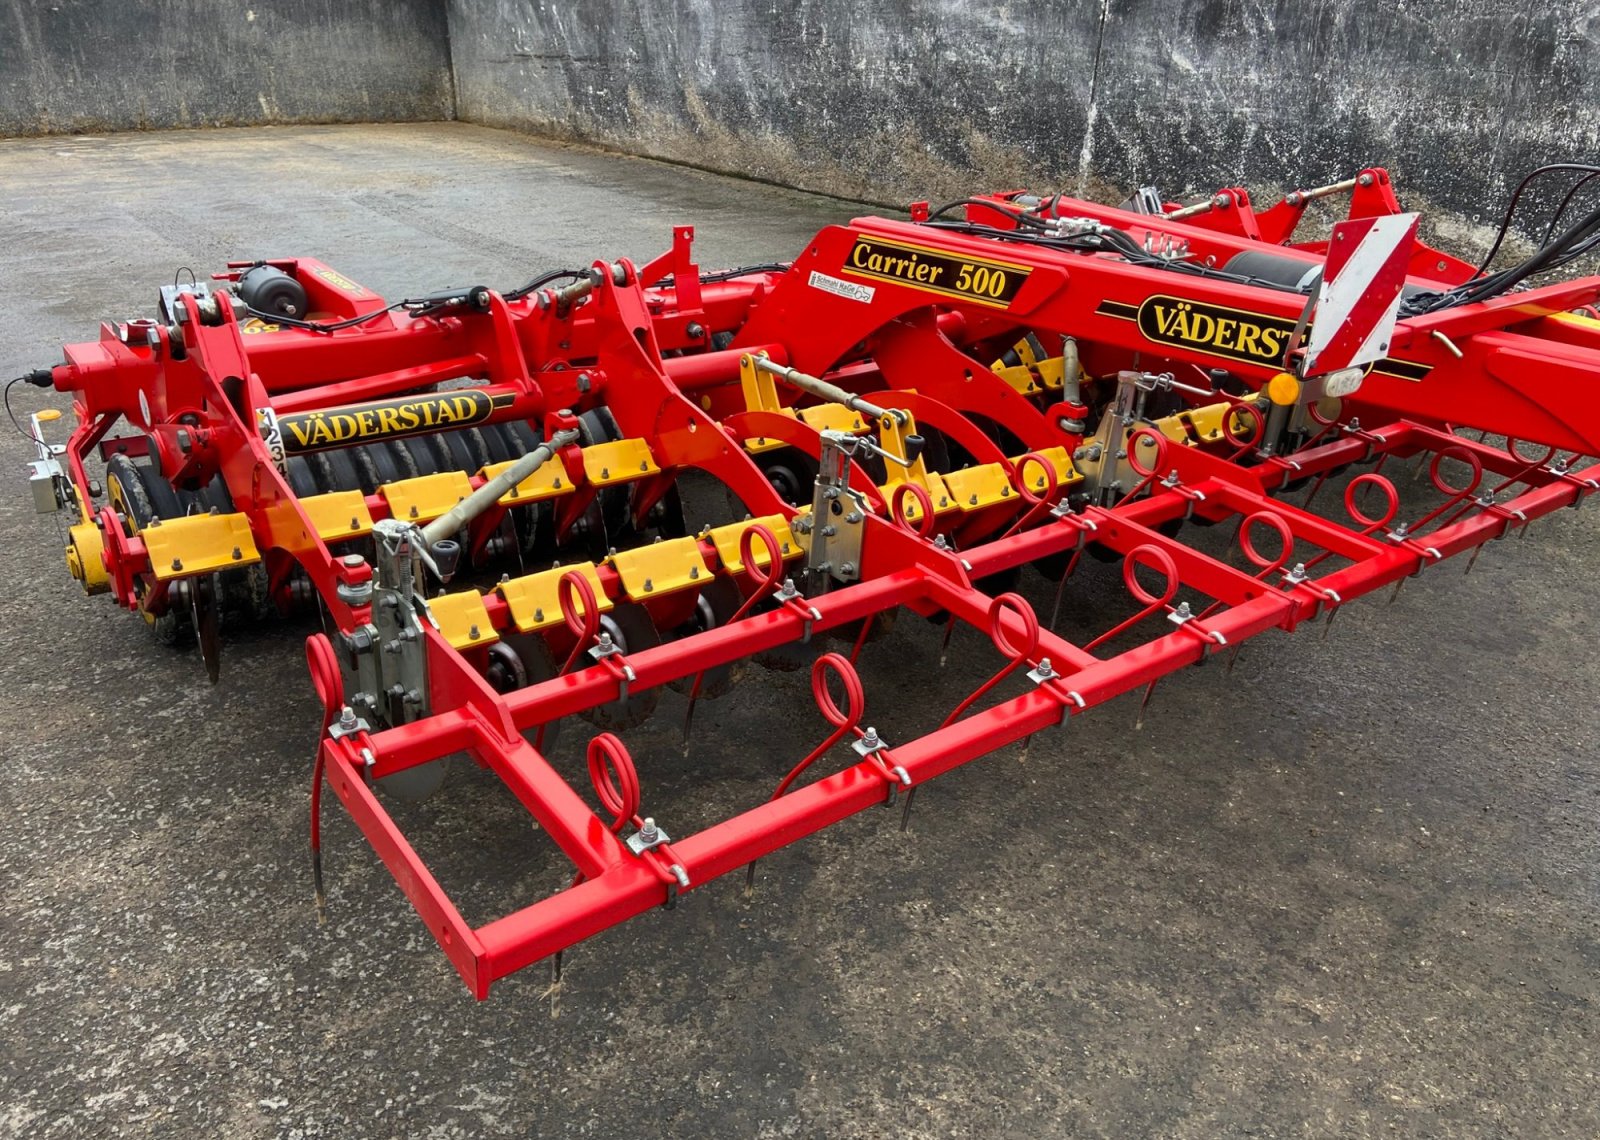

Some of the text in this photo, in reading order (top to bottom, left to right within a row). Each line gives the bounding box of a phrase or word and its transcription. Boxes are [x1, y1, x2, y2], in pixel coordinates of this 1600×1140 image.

[853, 243, 1006, 298] Carrier 500
[264, 411, 273, 427] 1
[286, 397, 477, 446] VÄDERSTAD
[269, 428, 280, 445] 2
[271, 445, 284, 462] 3
